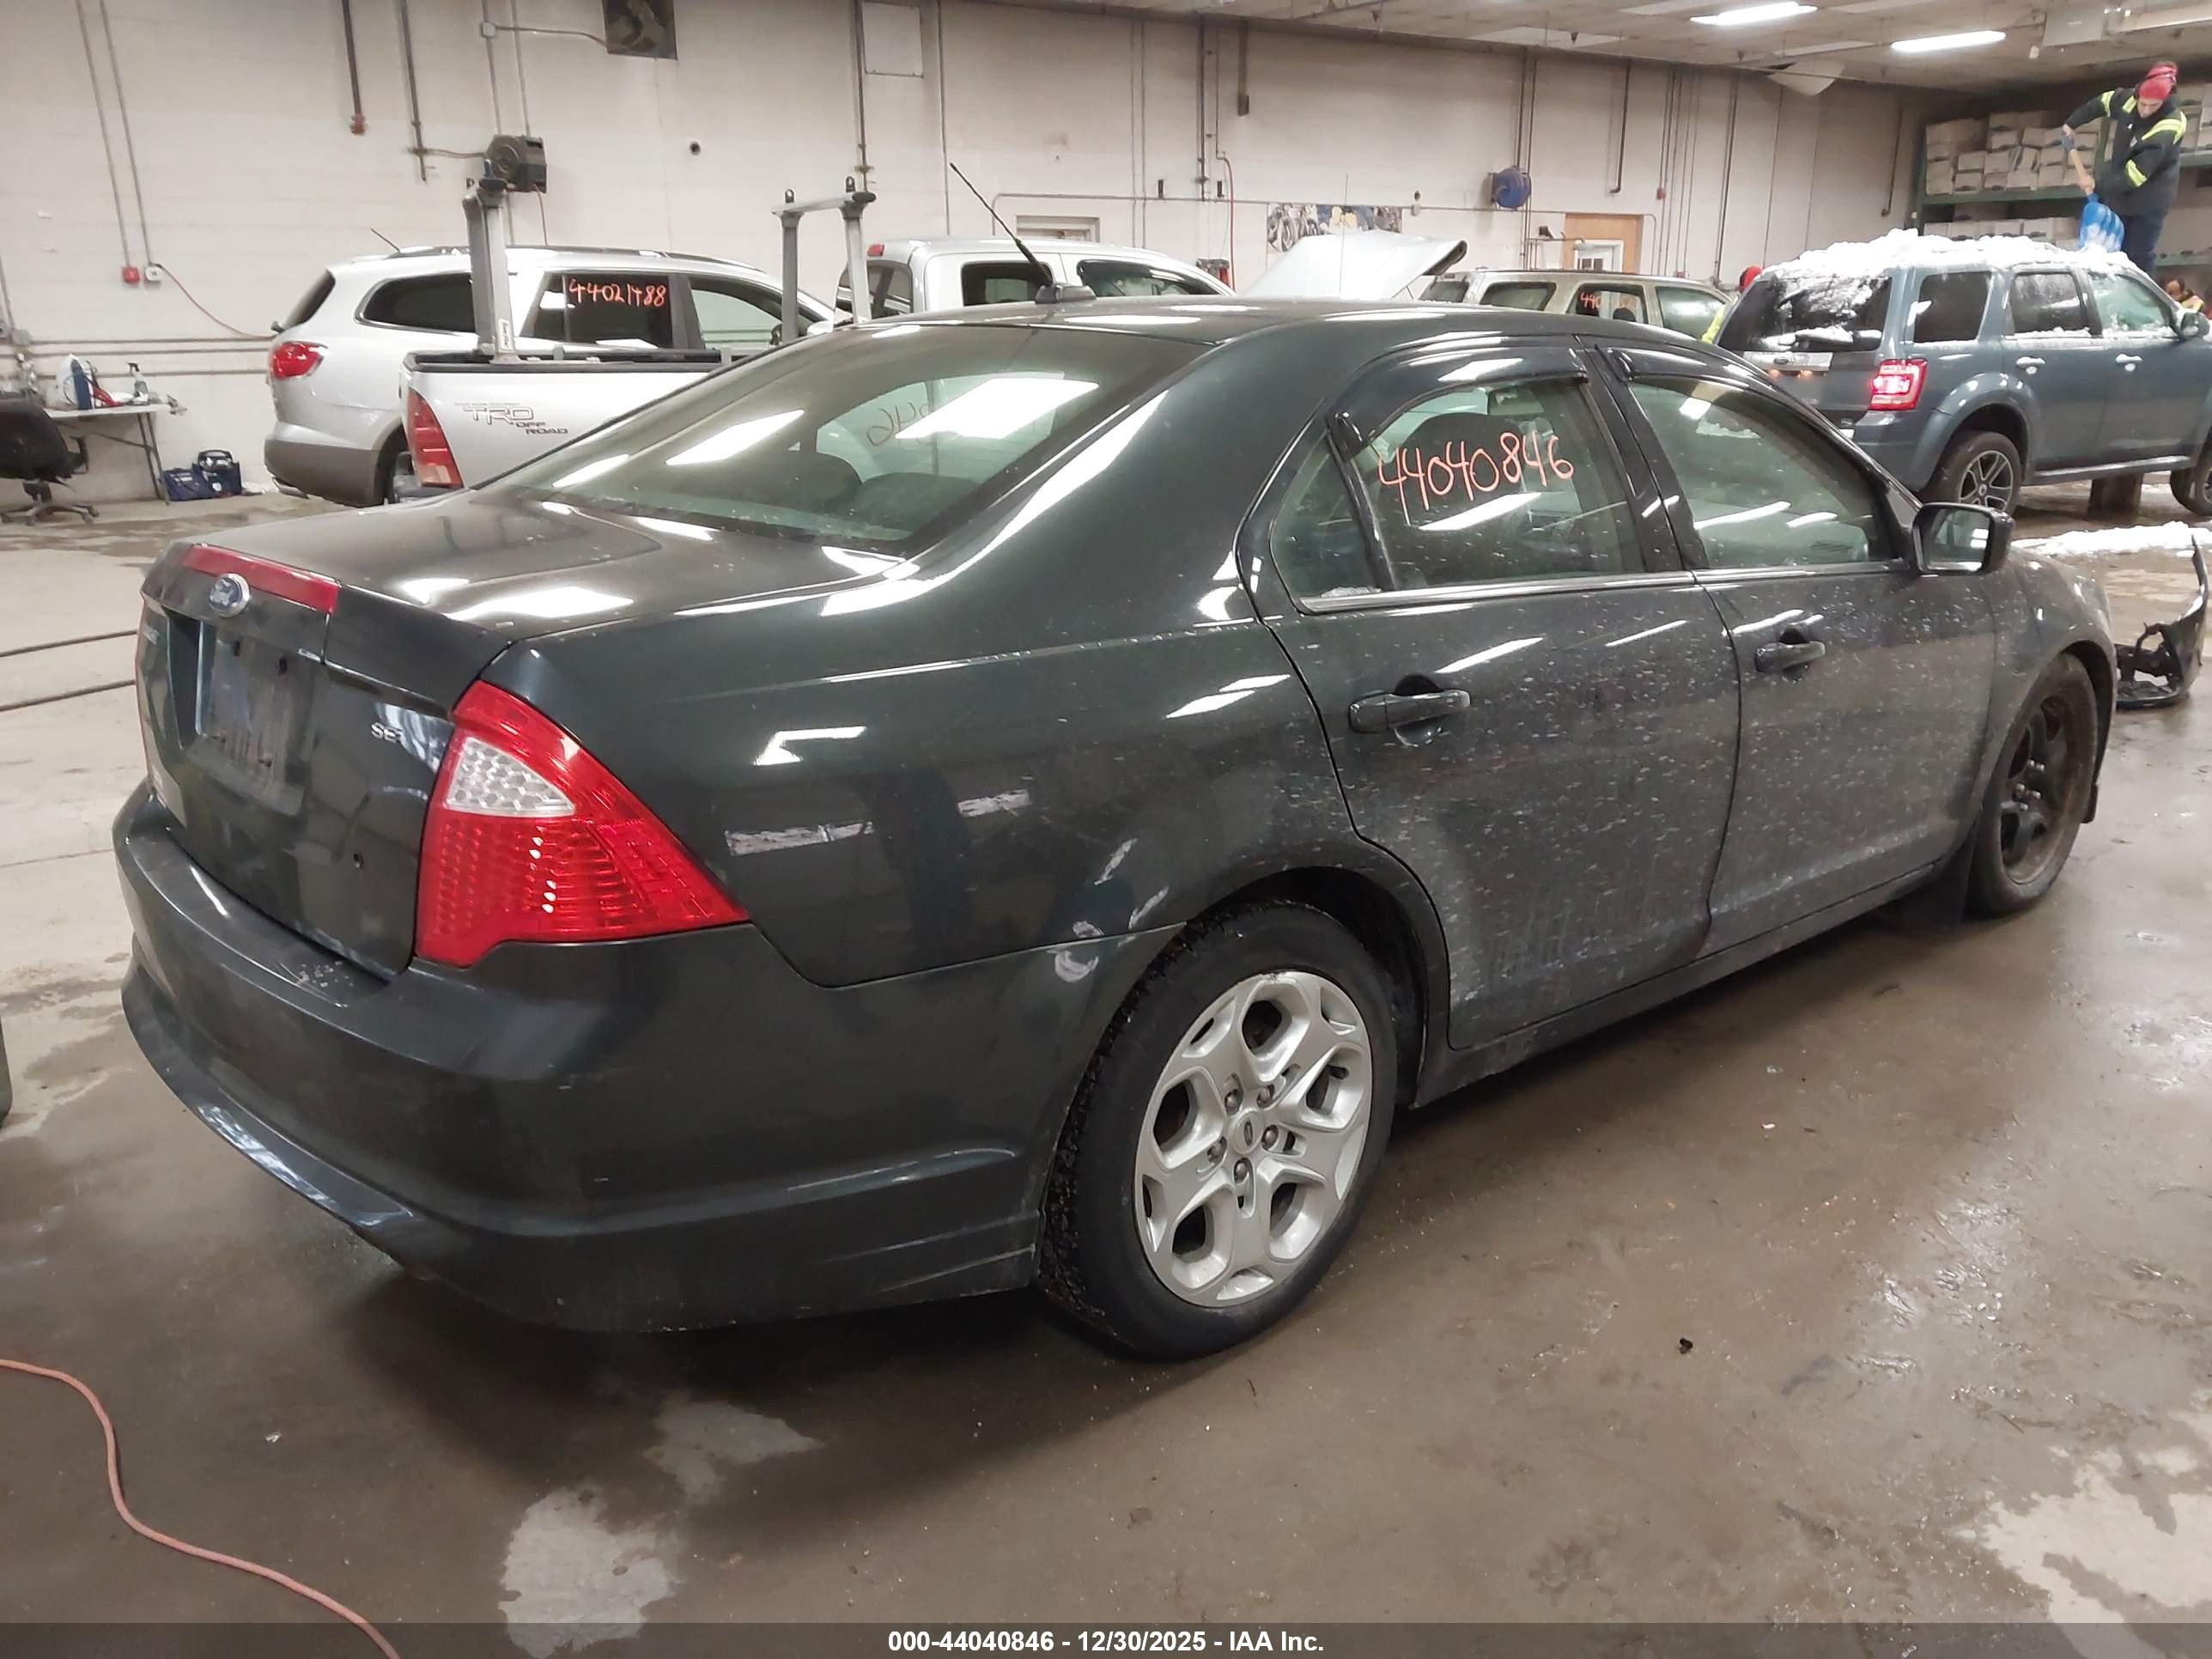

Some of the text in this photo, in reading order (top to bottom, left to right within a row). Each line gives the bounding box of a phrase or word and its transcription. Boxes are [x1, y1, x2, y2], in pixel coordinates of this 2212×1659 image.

[568, 278, 666, 307] 44021488
[464, 406, 534, 426] TRD
[1378, 429, 1574, 526] 44040846
